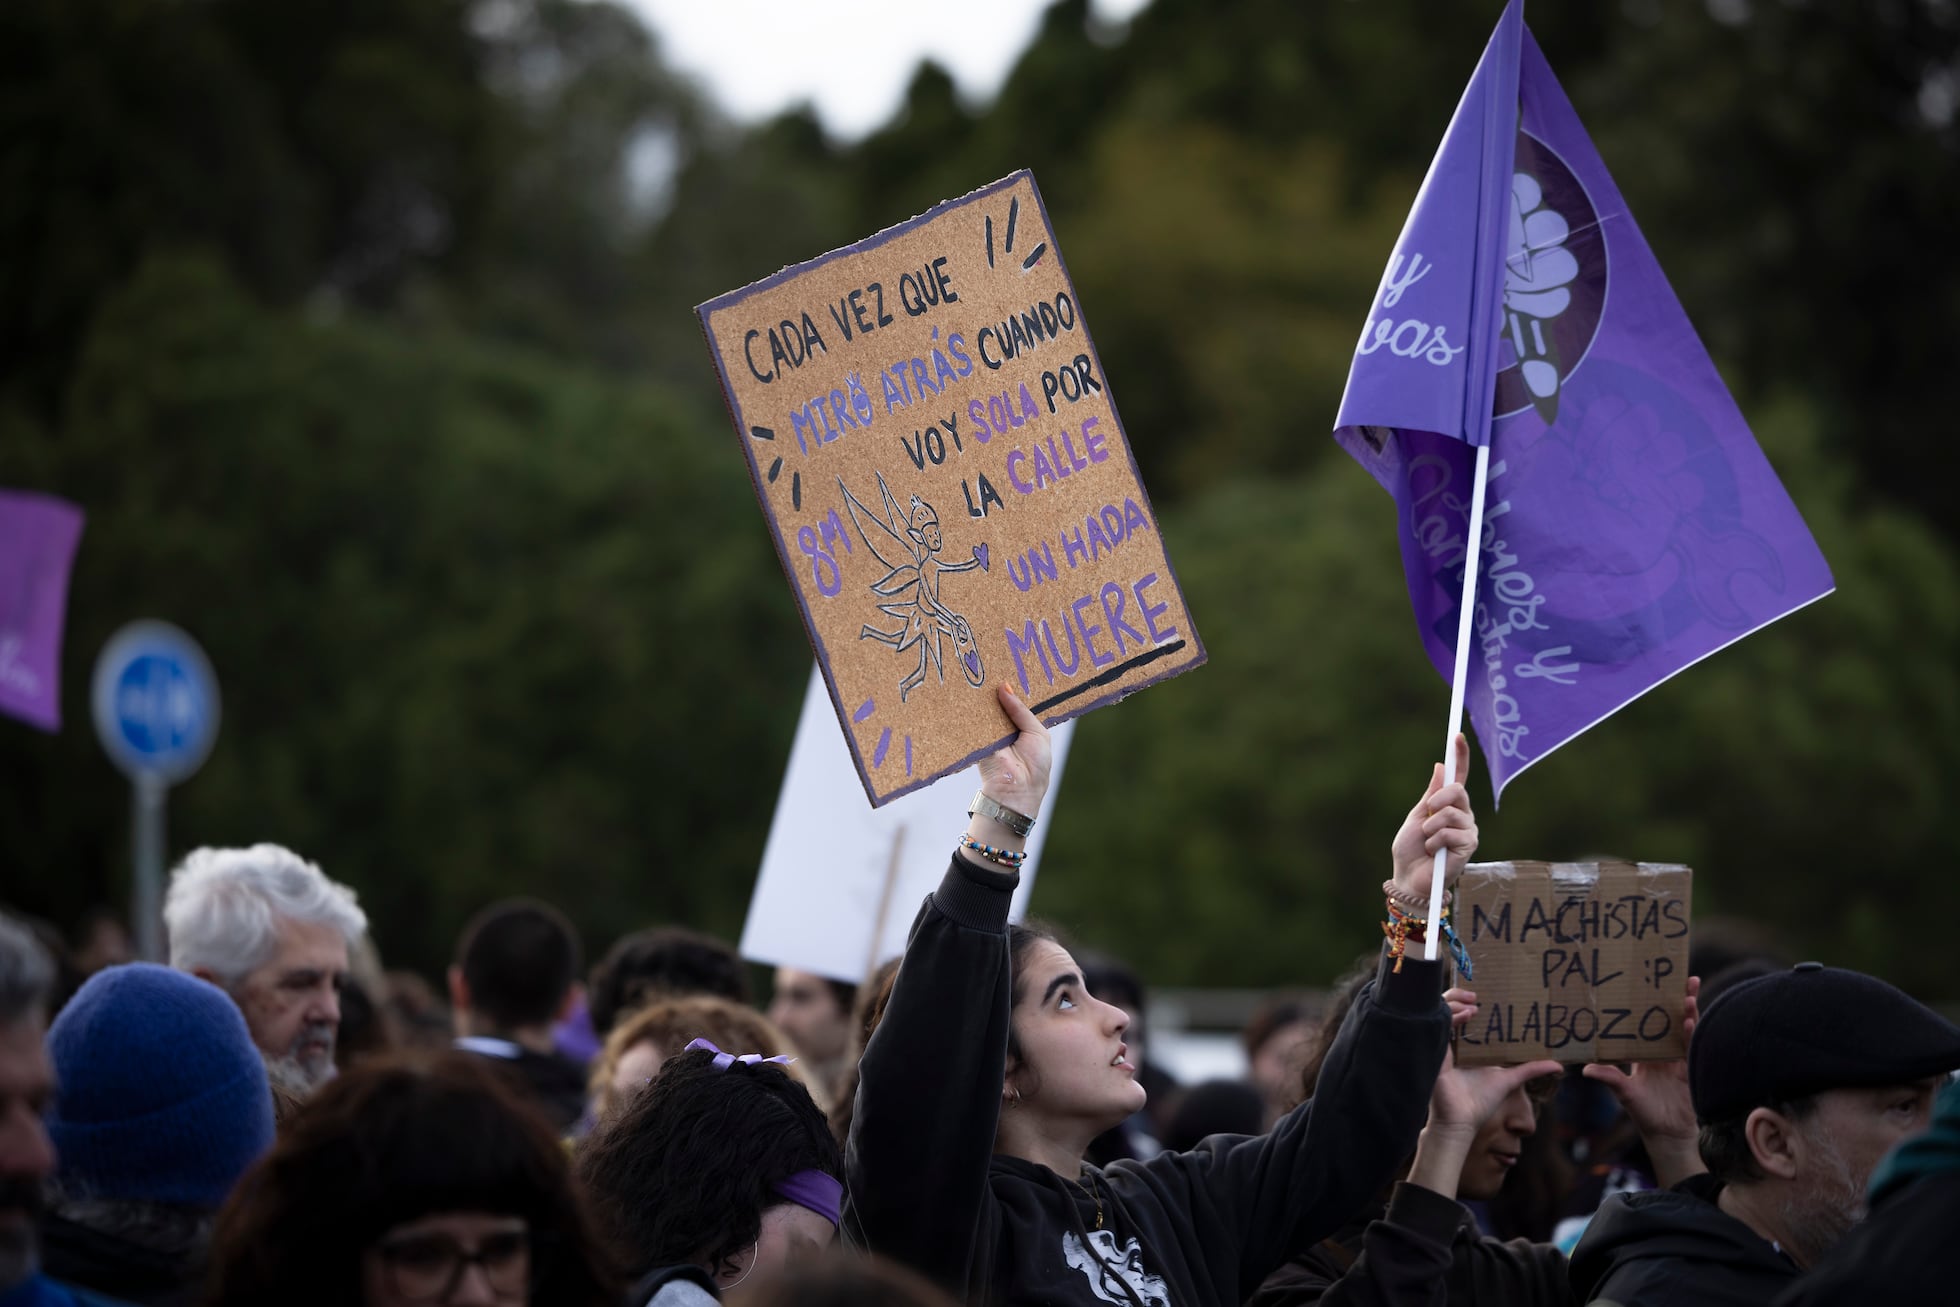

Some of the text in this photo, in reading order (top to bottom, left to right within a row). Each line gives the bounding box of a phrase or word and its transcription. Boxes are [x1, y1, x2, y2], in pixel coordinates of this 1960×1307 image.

[743, 256, 959, 384] CADA VEZ QUE
[1383, 252, 1432, 308] y
[880, 325, 974, 416] ATRÁS
[977, 292, 1075, 370] CUANDO
[901, 354, 1102, 472] VOY SOLA POR
[961, 416, 1110, 518] LA CALLE
[797, 508, 853, 598] 8M
[1005, 497, 1151, 592] UN HADA
[1005, 572, 1180, 697] MUERE
[1514, 645, 1580, 684] y
[1542, 948, 1623, 988] PAL
